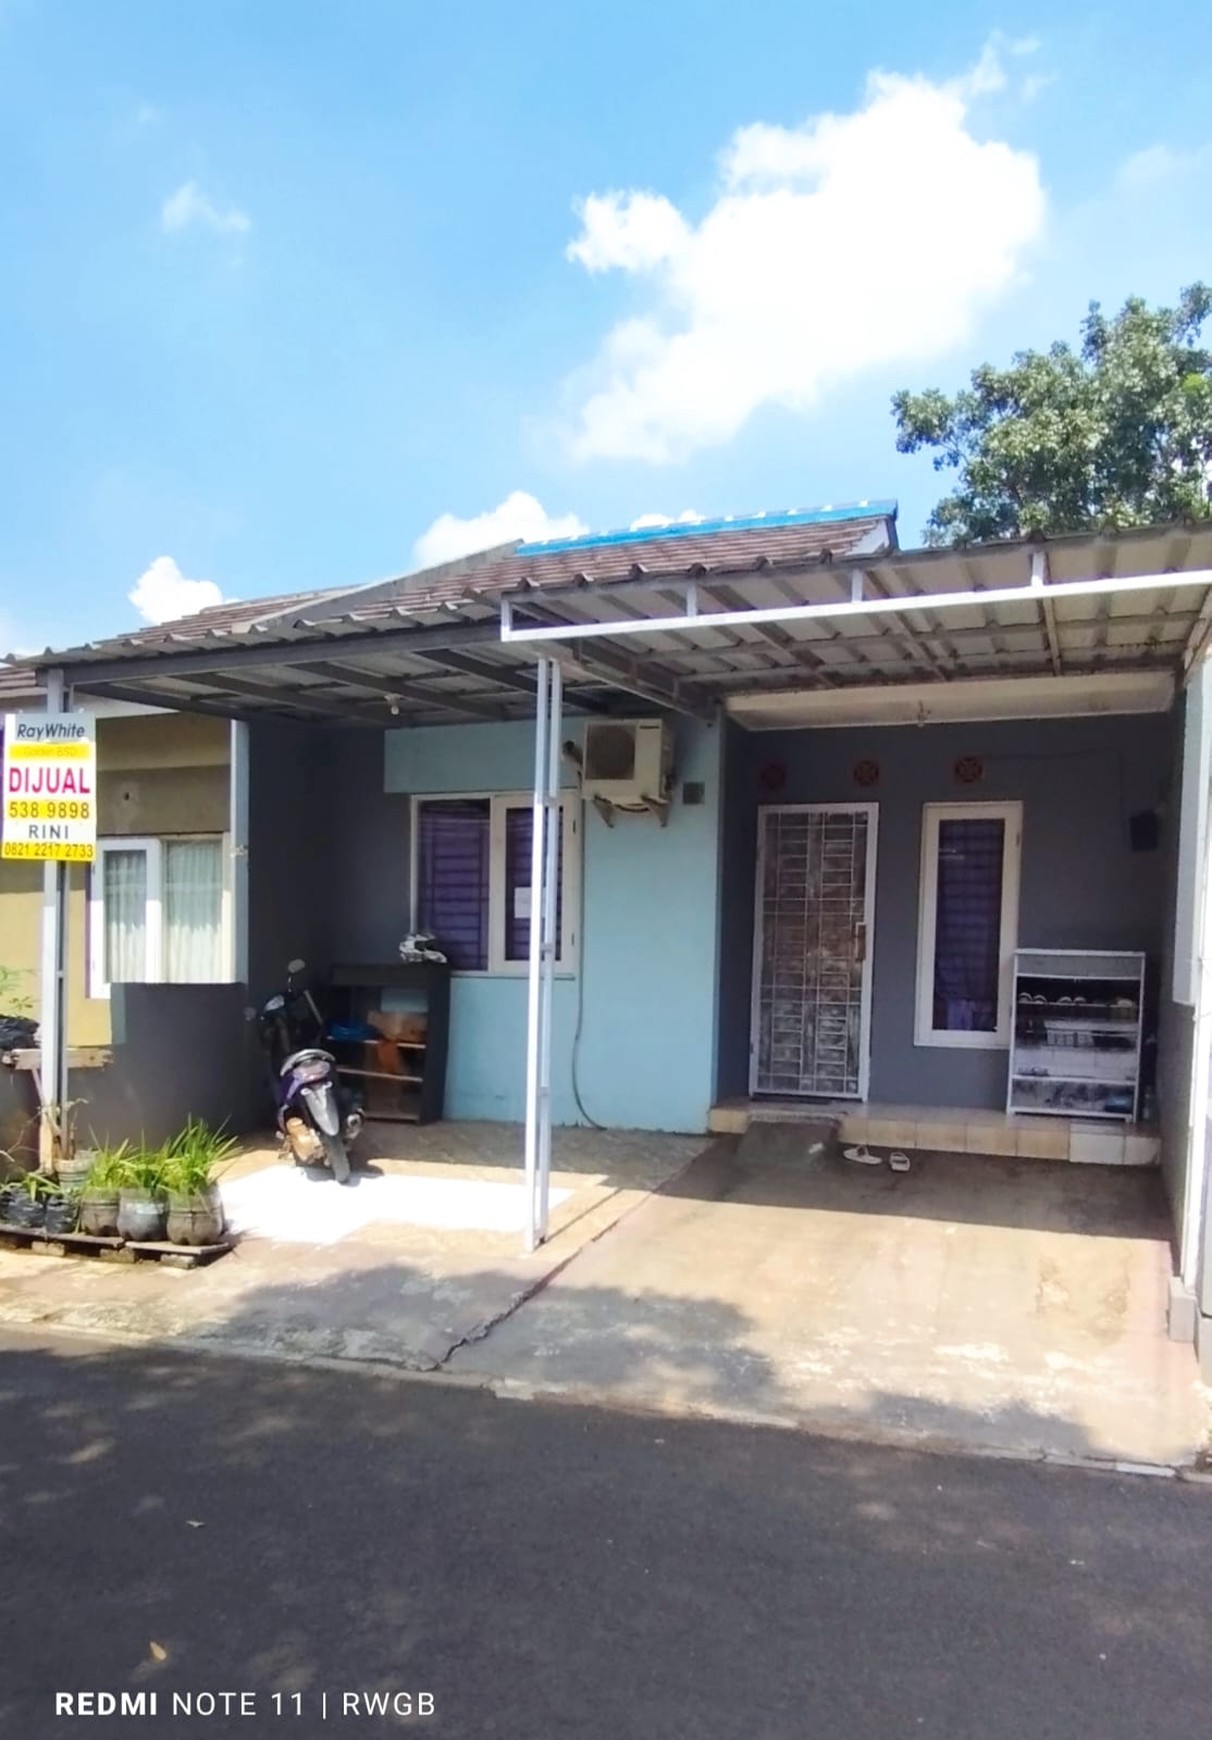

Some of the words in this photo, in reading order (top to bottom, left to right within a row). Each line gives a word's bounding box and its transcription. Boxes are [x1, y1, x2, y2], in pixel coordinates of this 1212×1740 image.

[17, 723, 86, 740] RayWhite
[8, 767, 91, 793] DIJUAL
[8, 801, 40, 819] 538
[47, 802, 90, 819] 9898
[28, 825, 69, 839] RINI
[4, 843, 29, 856] 0821
[34, 843, 61, 857] 2217
[65, 844, 94, 858] 2733
